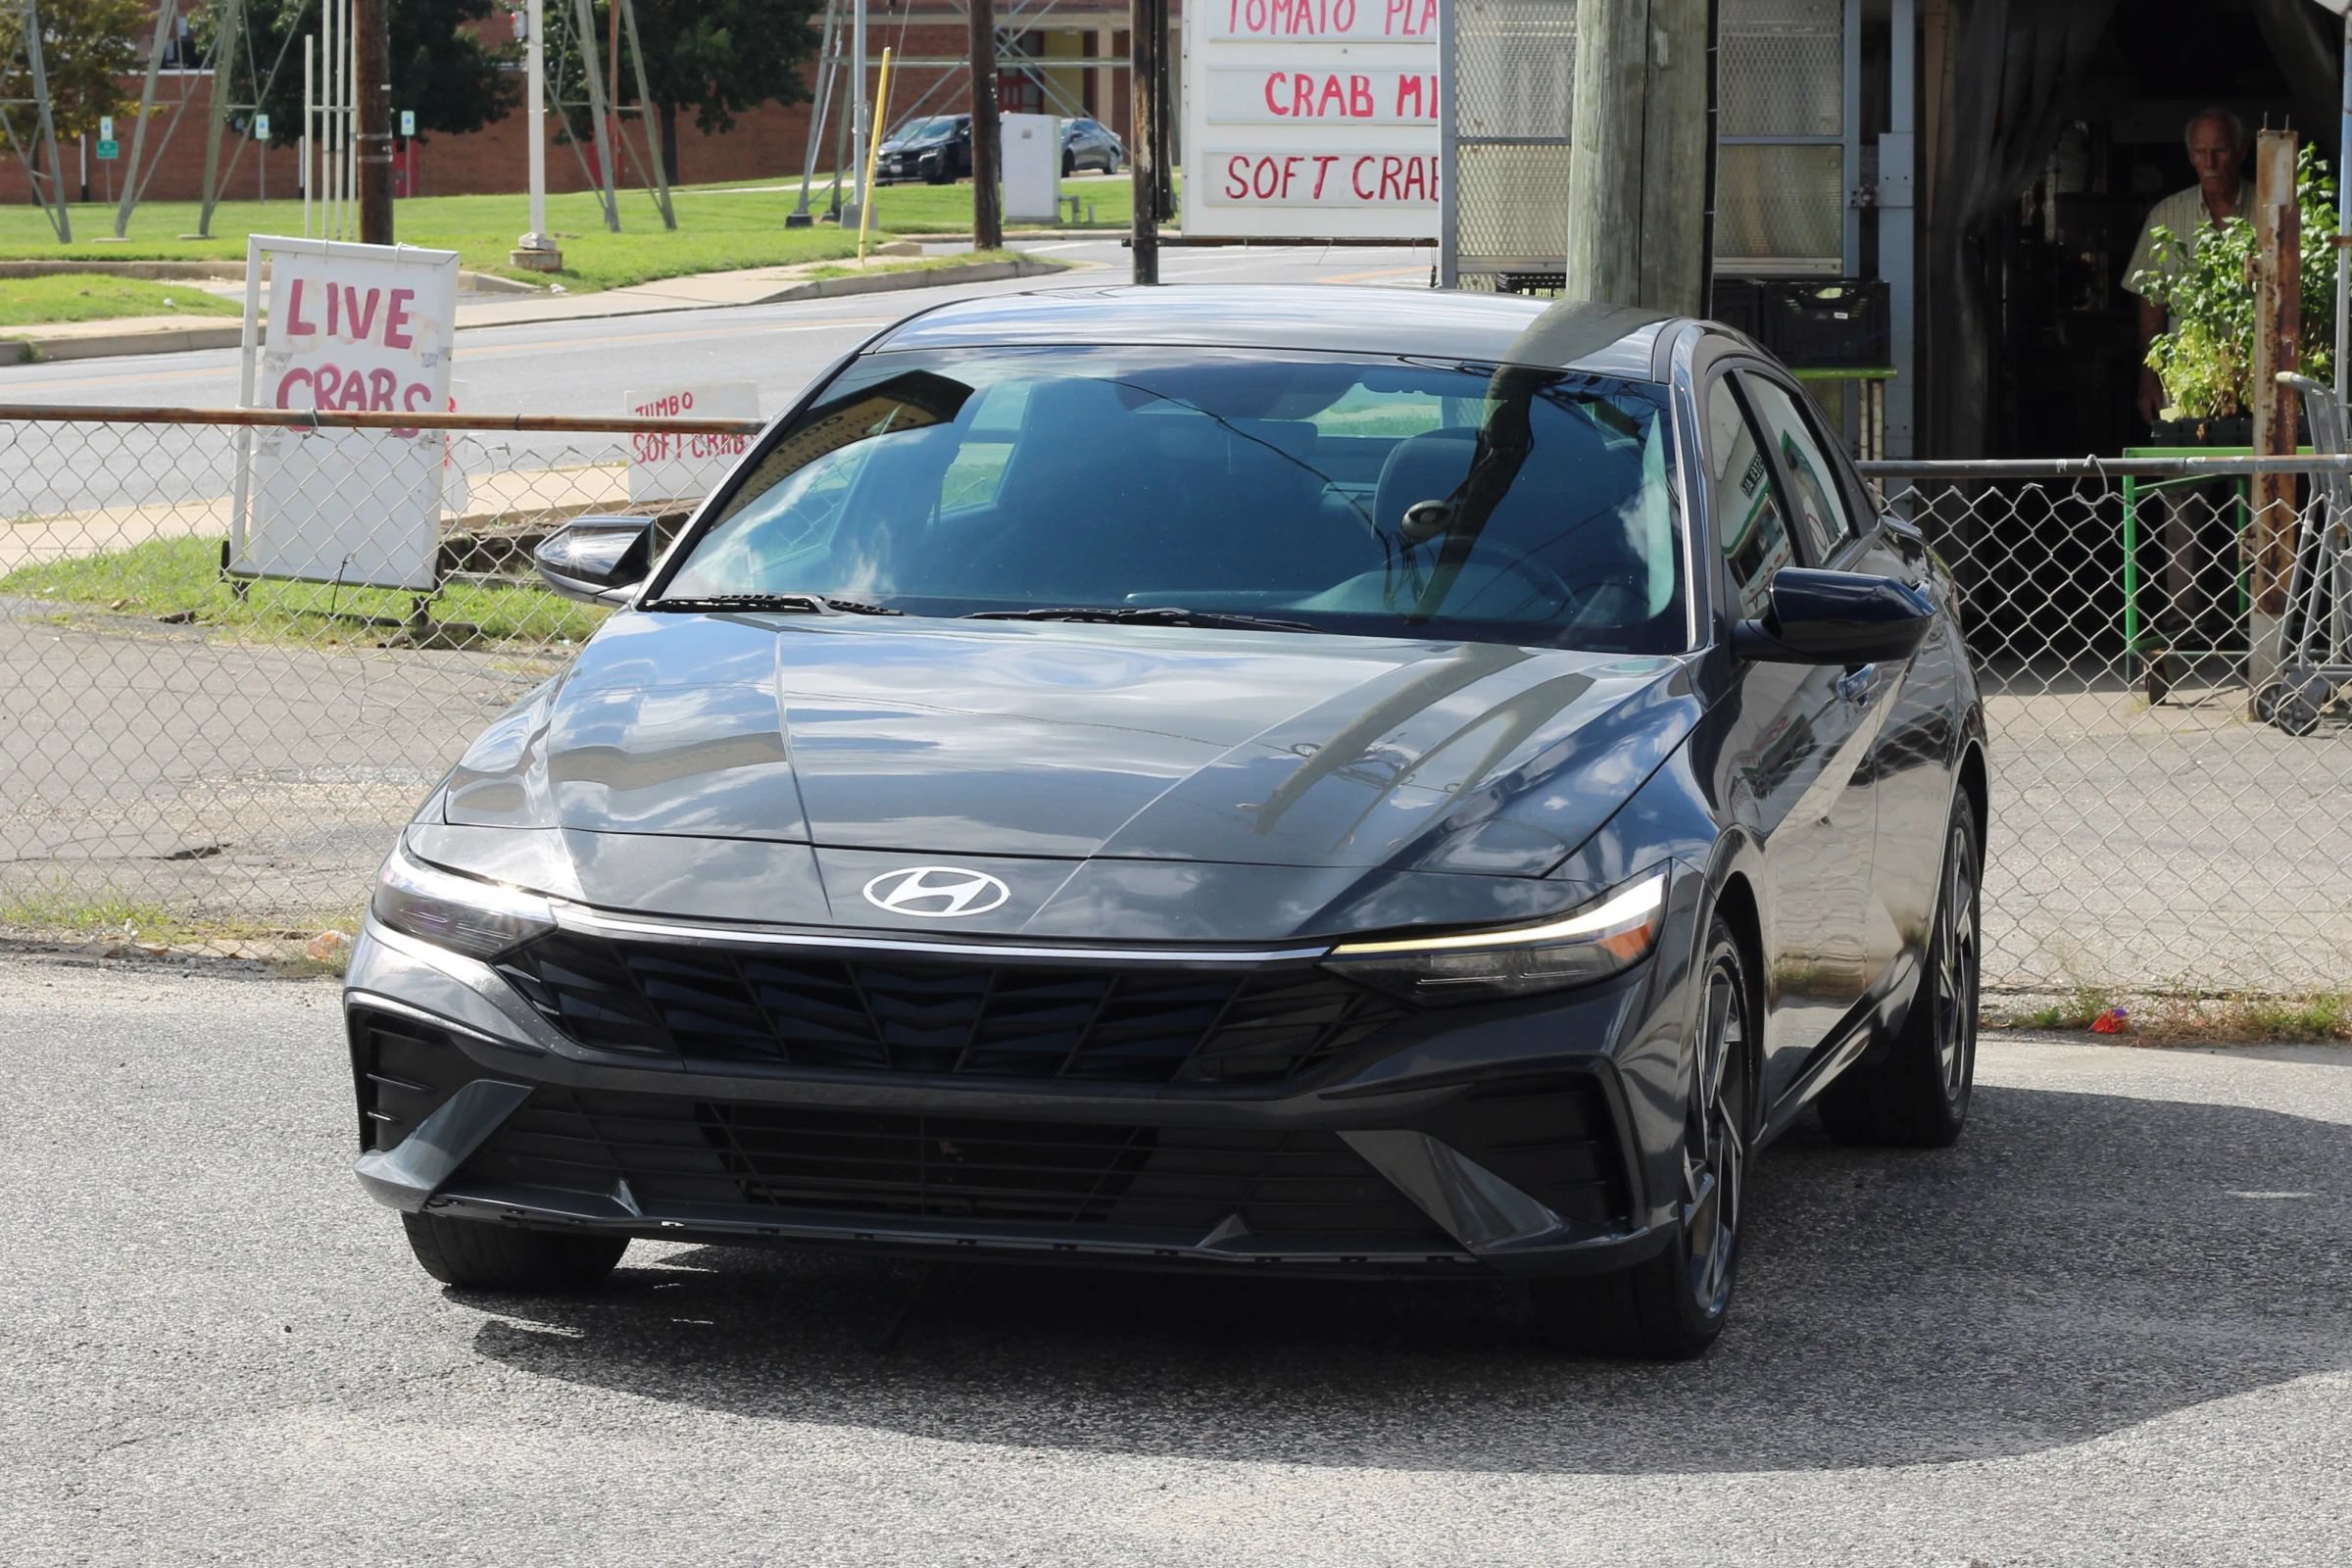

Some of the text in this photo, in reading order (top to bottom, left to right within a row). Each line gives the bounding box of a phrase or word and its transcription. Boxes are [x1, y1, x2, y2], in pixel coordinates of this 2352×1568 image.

[1228, 0, 1355, 35] TOMATO
[1264, 72, 1374, 118] CRAB
[1225, 156, 1340, 200] SOFT
[286, 278, 415, 350] LIVE
[276, 364, 431, 439] CRABS
[692, 432, 755, 459] CRAB
